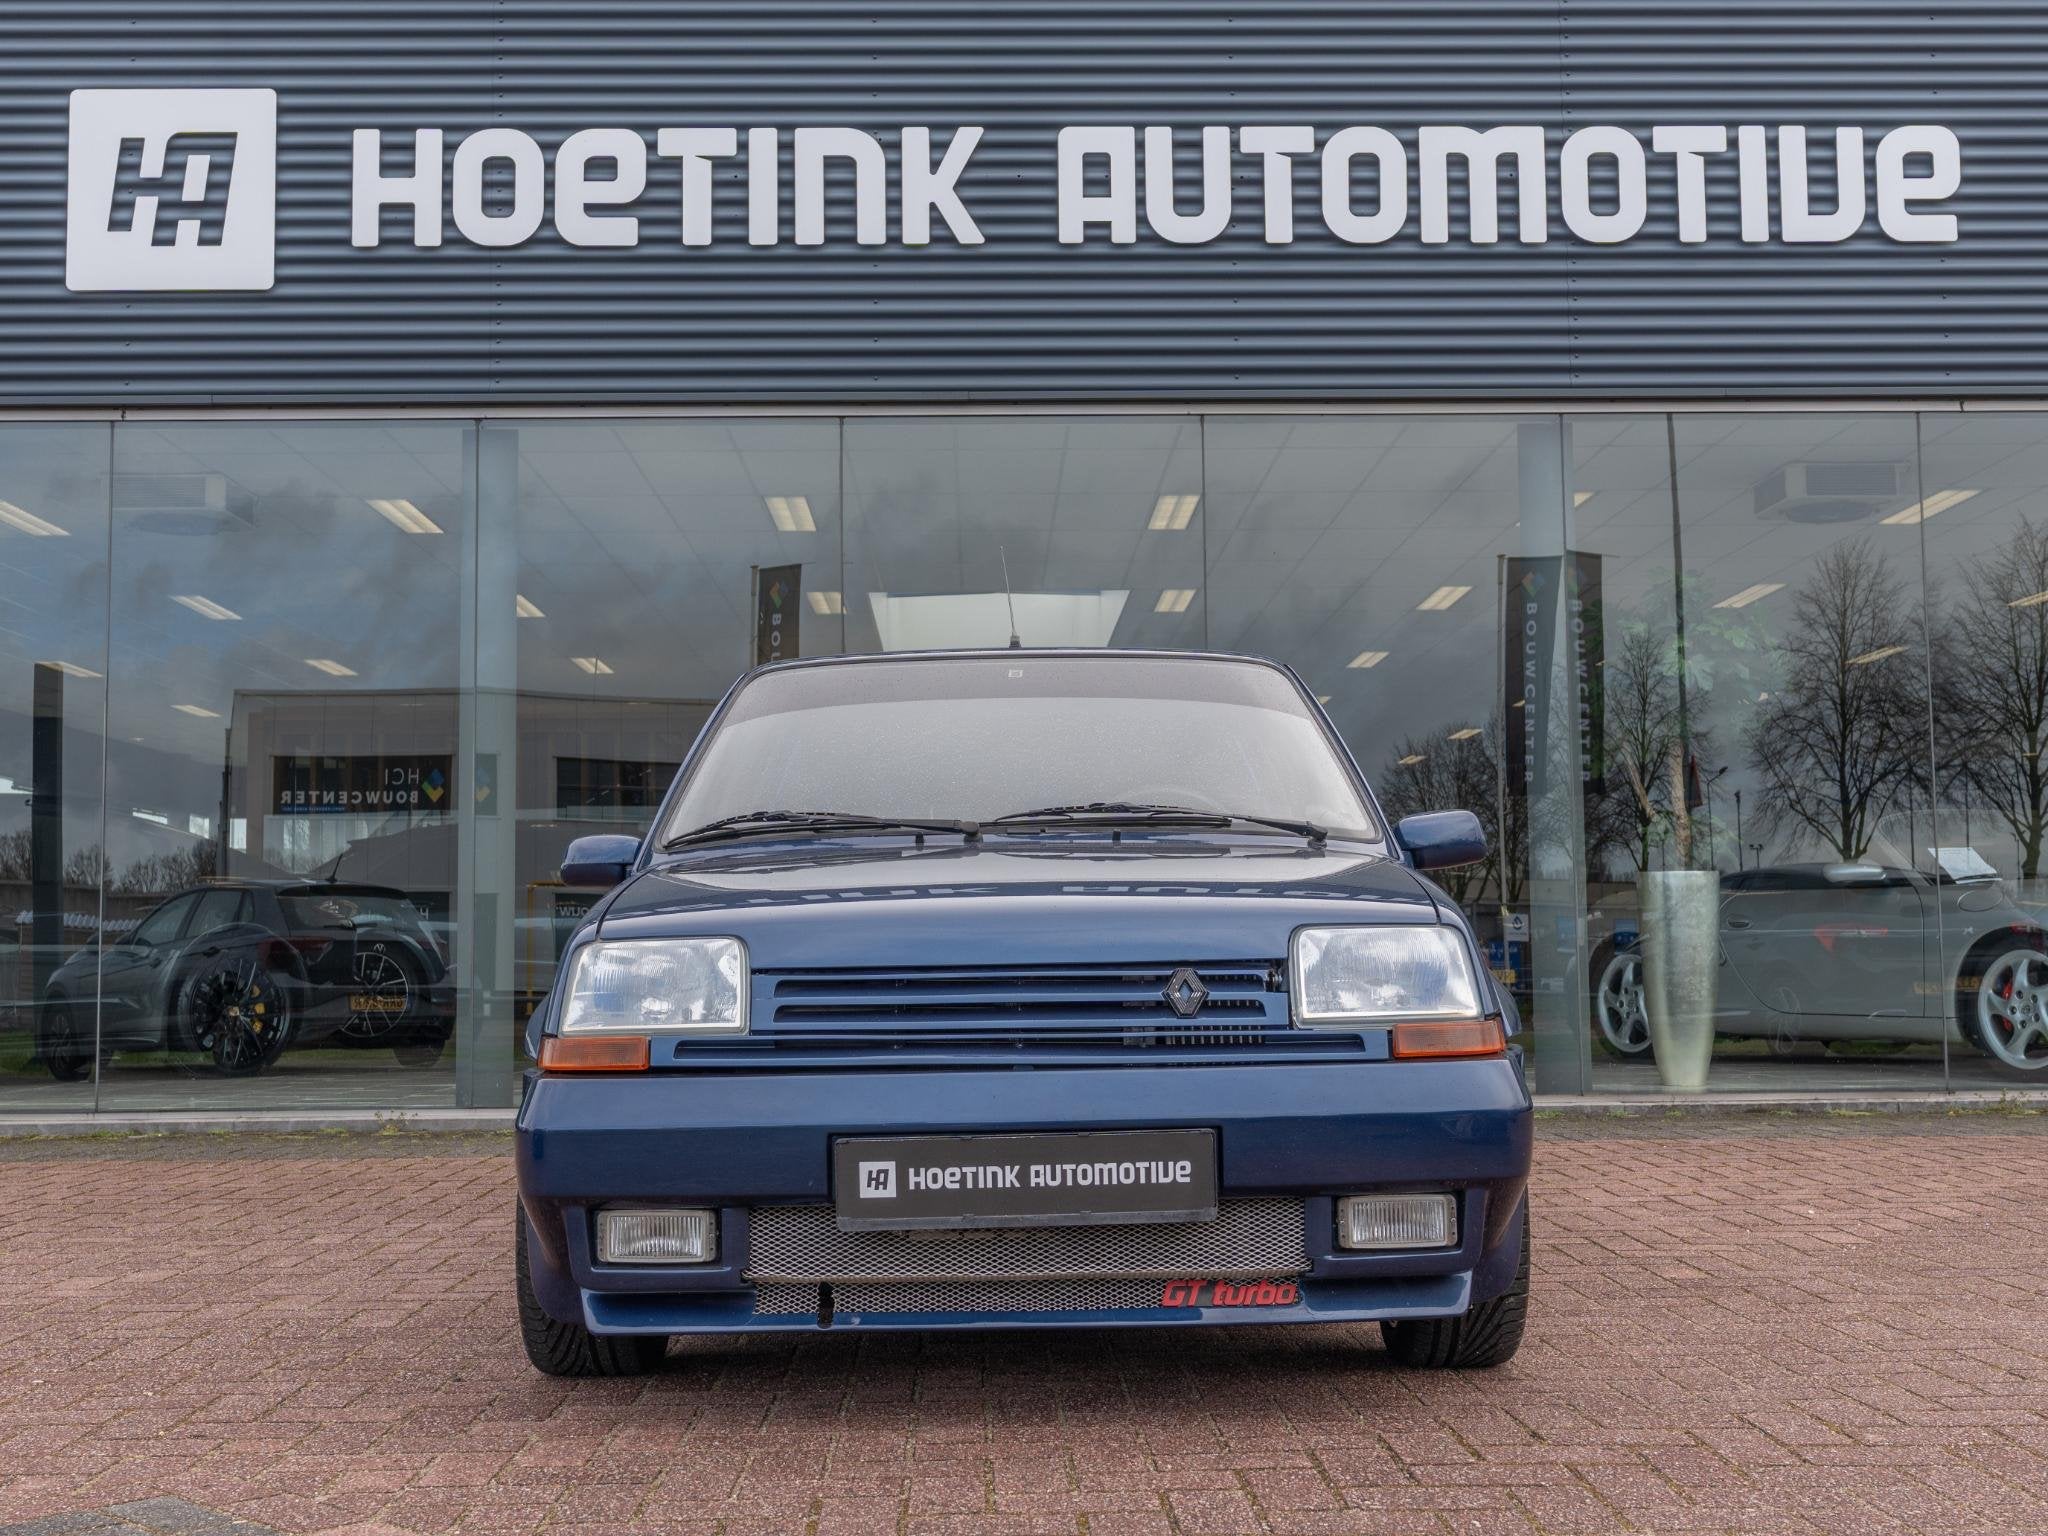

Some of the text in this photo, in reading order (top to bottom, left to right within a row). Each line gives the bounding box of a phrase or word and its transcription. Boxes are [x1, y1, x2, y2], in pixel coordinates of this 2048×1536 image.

[1523, 602, 1538, 783] BOUWCENTER
[1161, 1278, 1298, 1307] GT turbo
